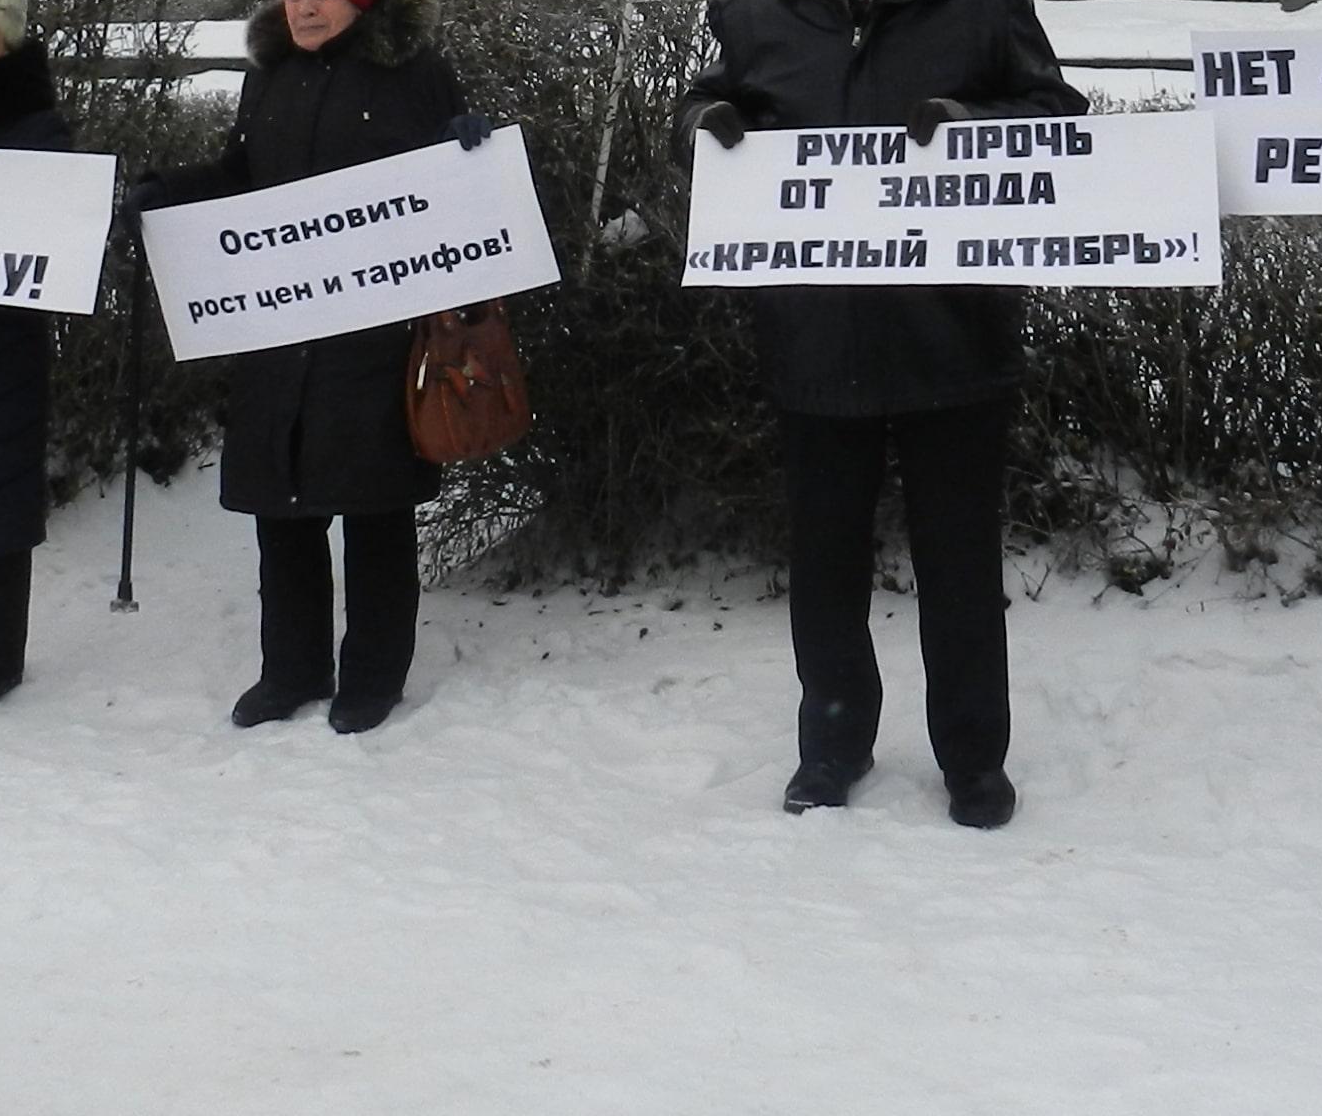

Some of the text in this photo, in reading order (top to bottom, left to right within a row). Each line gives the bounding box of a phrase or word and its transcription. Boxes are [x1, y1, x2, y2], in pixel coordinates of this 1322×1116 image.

[1202, 48, 1296, 97] НЕТ
[796, 121, 1093, 167] РУКИ ПРОЧЬ
[780, 171, 1056, 210] ОТ ЗАВОДА
[219, 193, 430, 255] Остановить
[688, 229, 1200, 272] «КРАСНЫЙ ОКТЯБРЬ»!
[188, 228, 514, 324] рост цен и тарифов!
